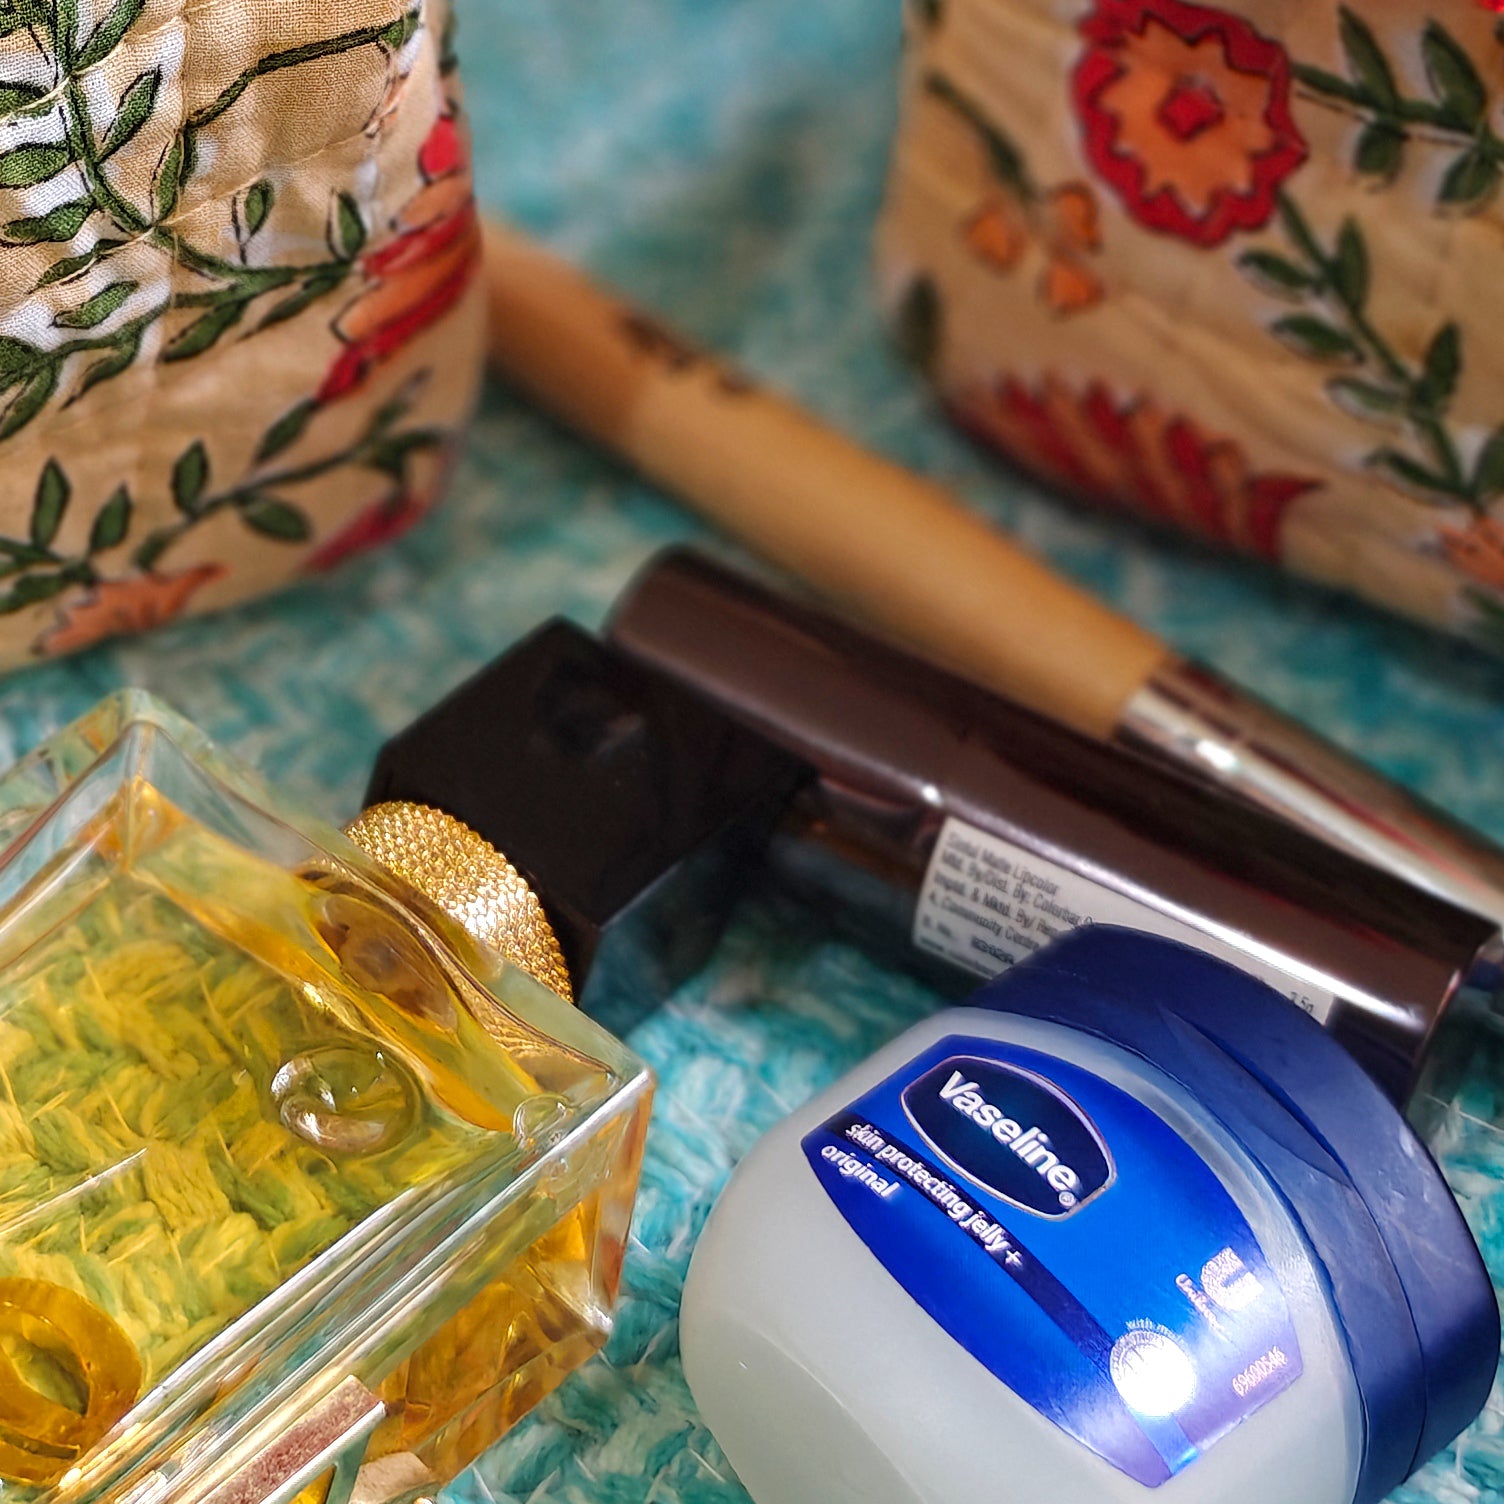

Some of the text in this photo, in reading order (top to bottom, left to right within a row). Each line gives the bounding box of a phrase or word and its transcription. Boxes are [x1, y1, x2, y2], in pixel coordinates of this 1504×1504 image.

[820, 1144, 901, 1199] original
[845, 1121, 884, 1152] skin
[876, 1143, 972, 1225] protecting
[958, 1210, 1010, 1253] jelly
[938, 1069, 1081, 1195] Vaseline
